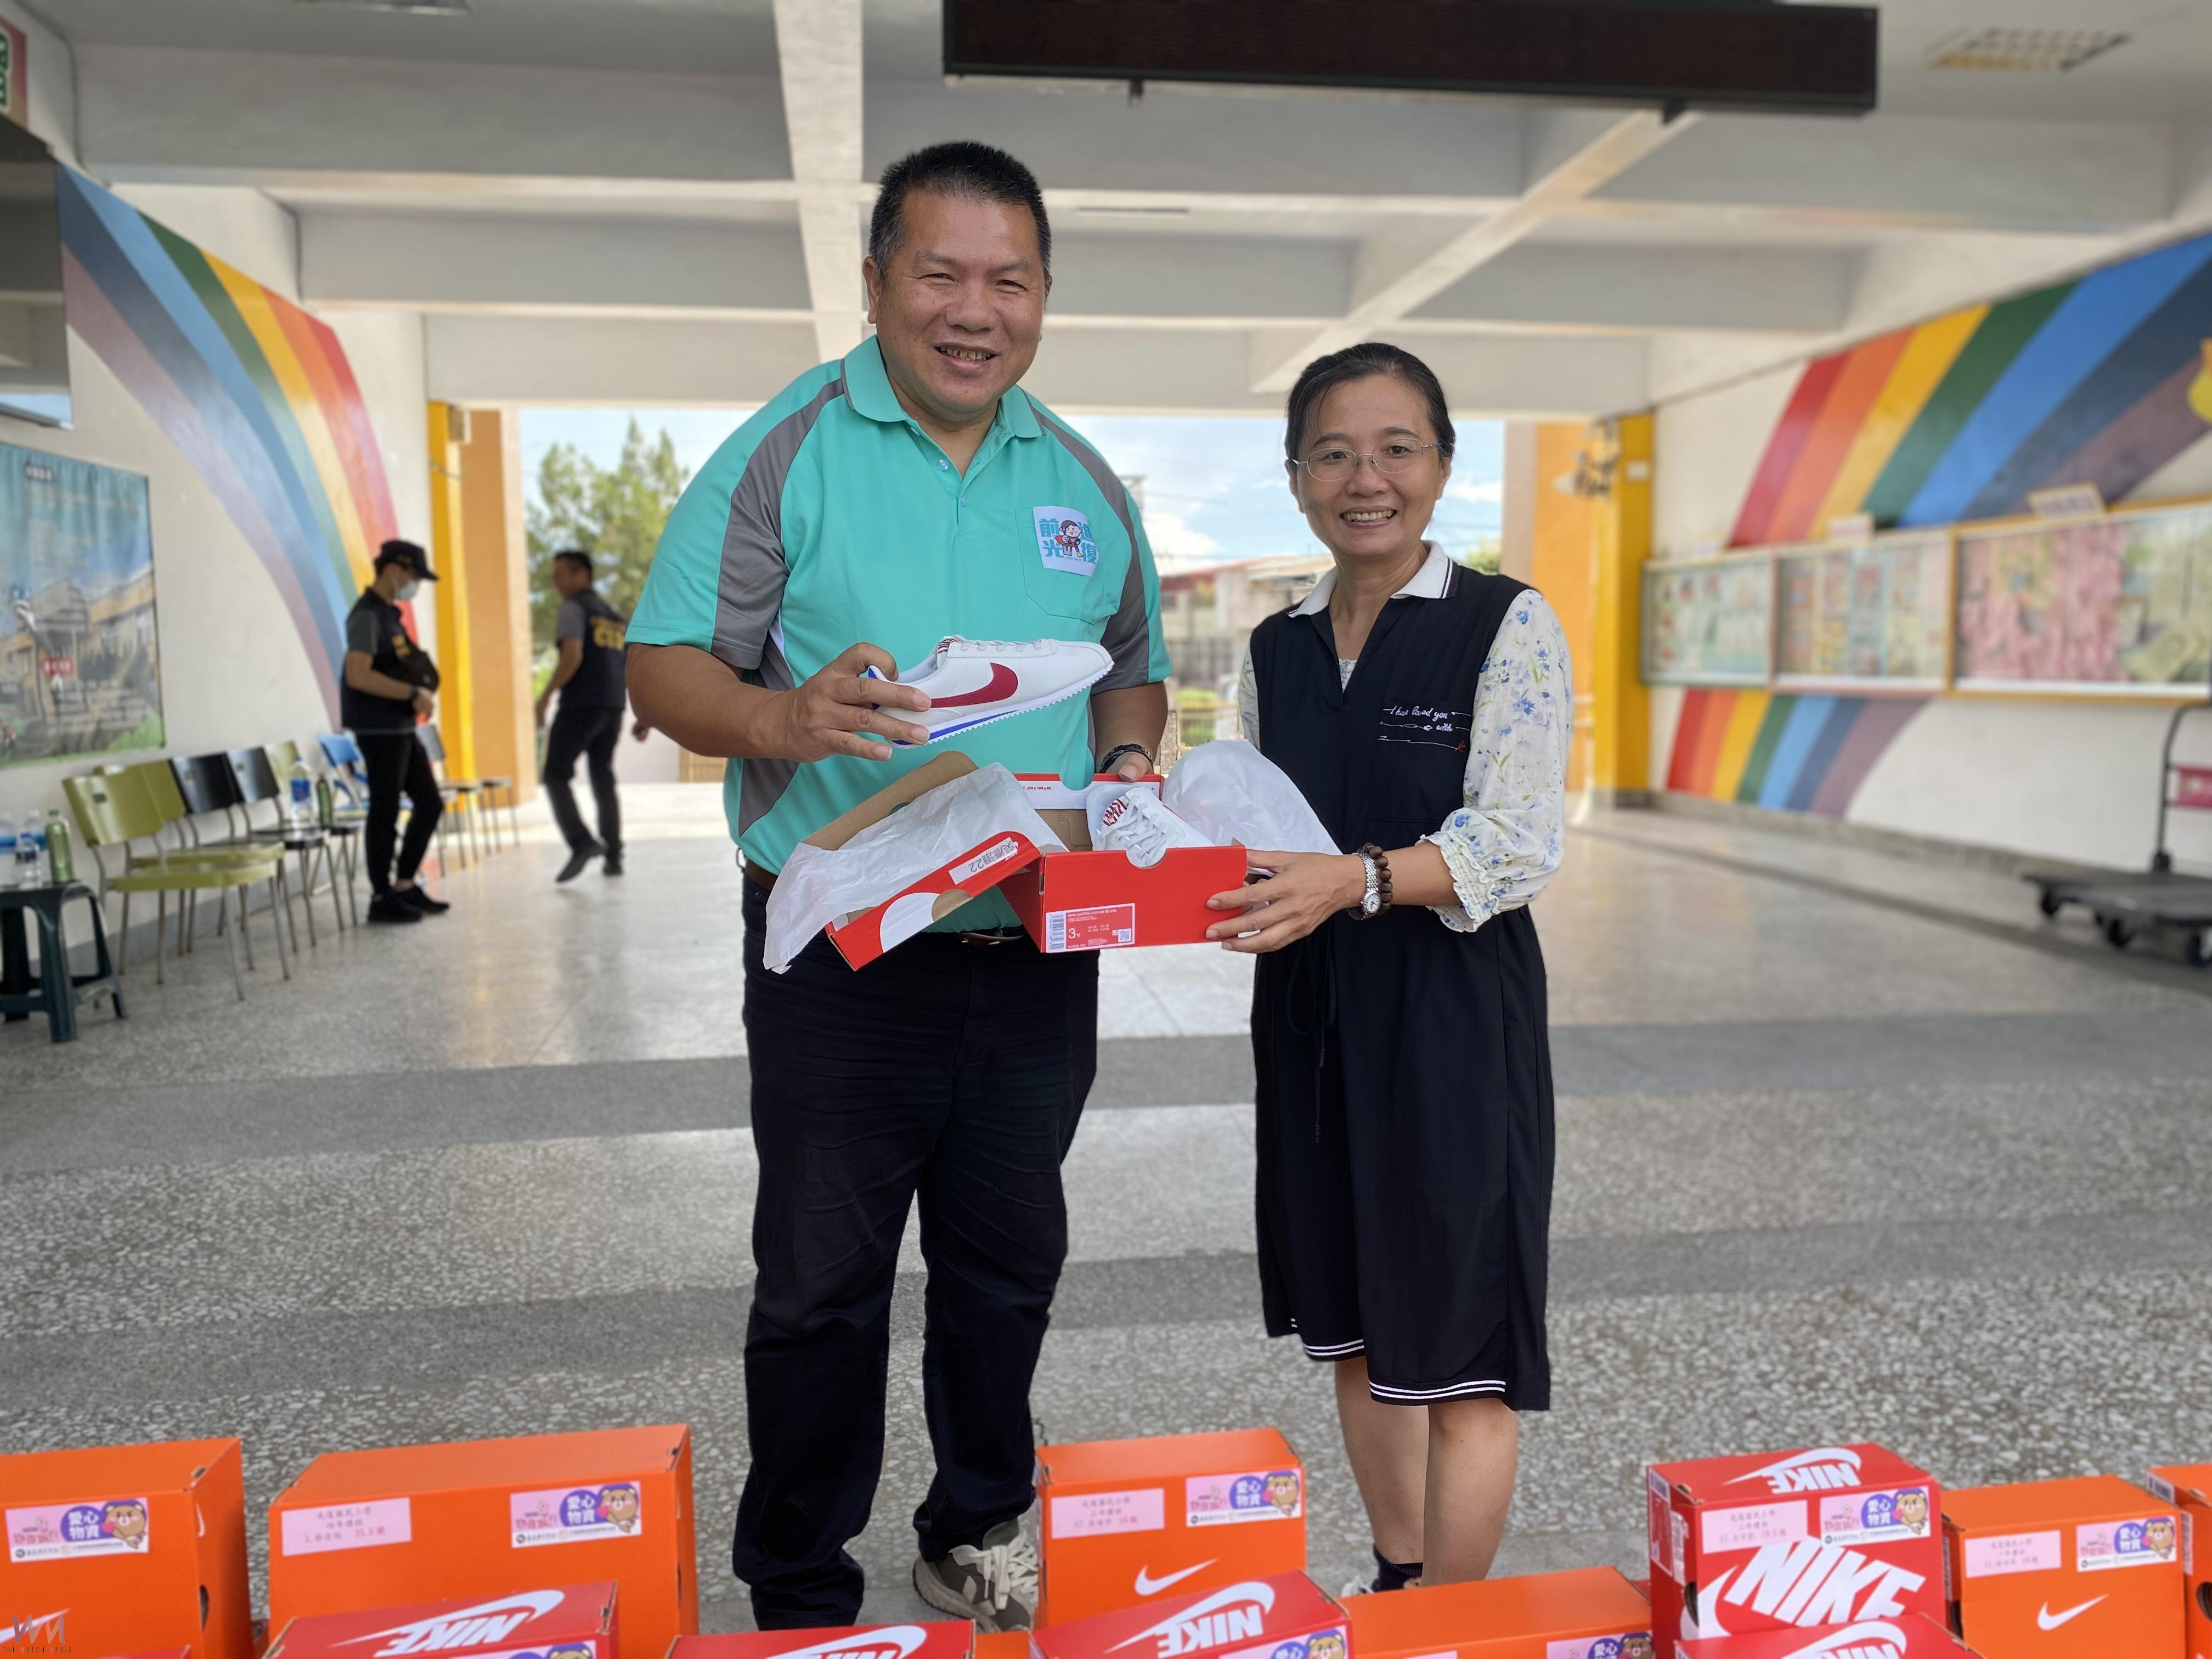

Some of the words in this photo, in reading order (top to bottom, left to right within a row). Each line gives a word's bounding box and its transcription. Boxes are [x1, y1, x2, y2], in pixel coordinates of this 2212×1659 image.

[1768, 1463, 1861, 1494] NIKE
[1236, 1480, 1261, 1494] 愛心
[566, 1494, 596, 1510] 愛心
[1236, 1493, 1261, 1508] 物資
[1867, 1499, 1891, 1513] 愛心
[67, 1510, 99, 1525] 愛心
[567, 1508, 596, 1525] 物資
[1867, 1511, 1891, 1526] 物資
[68, 1524, 100, 1541] 物資
[2119, 1527, 2142, 1538] 愛心
[2119, 1538, 2141, 1553] 物資
[1723, 1534, 1926, 1628] NIKE
[373, 1611, 531, 1658] NIKE
[1157, 1604, 1263, 1658] NIKE
[1594, 1643, 1618, 1656] 愛心
